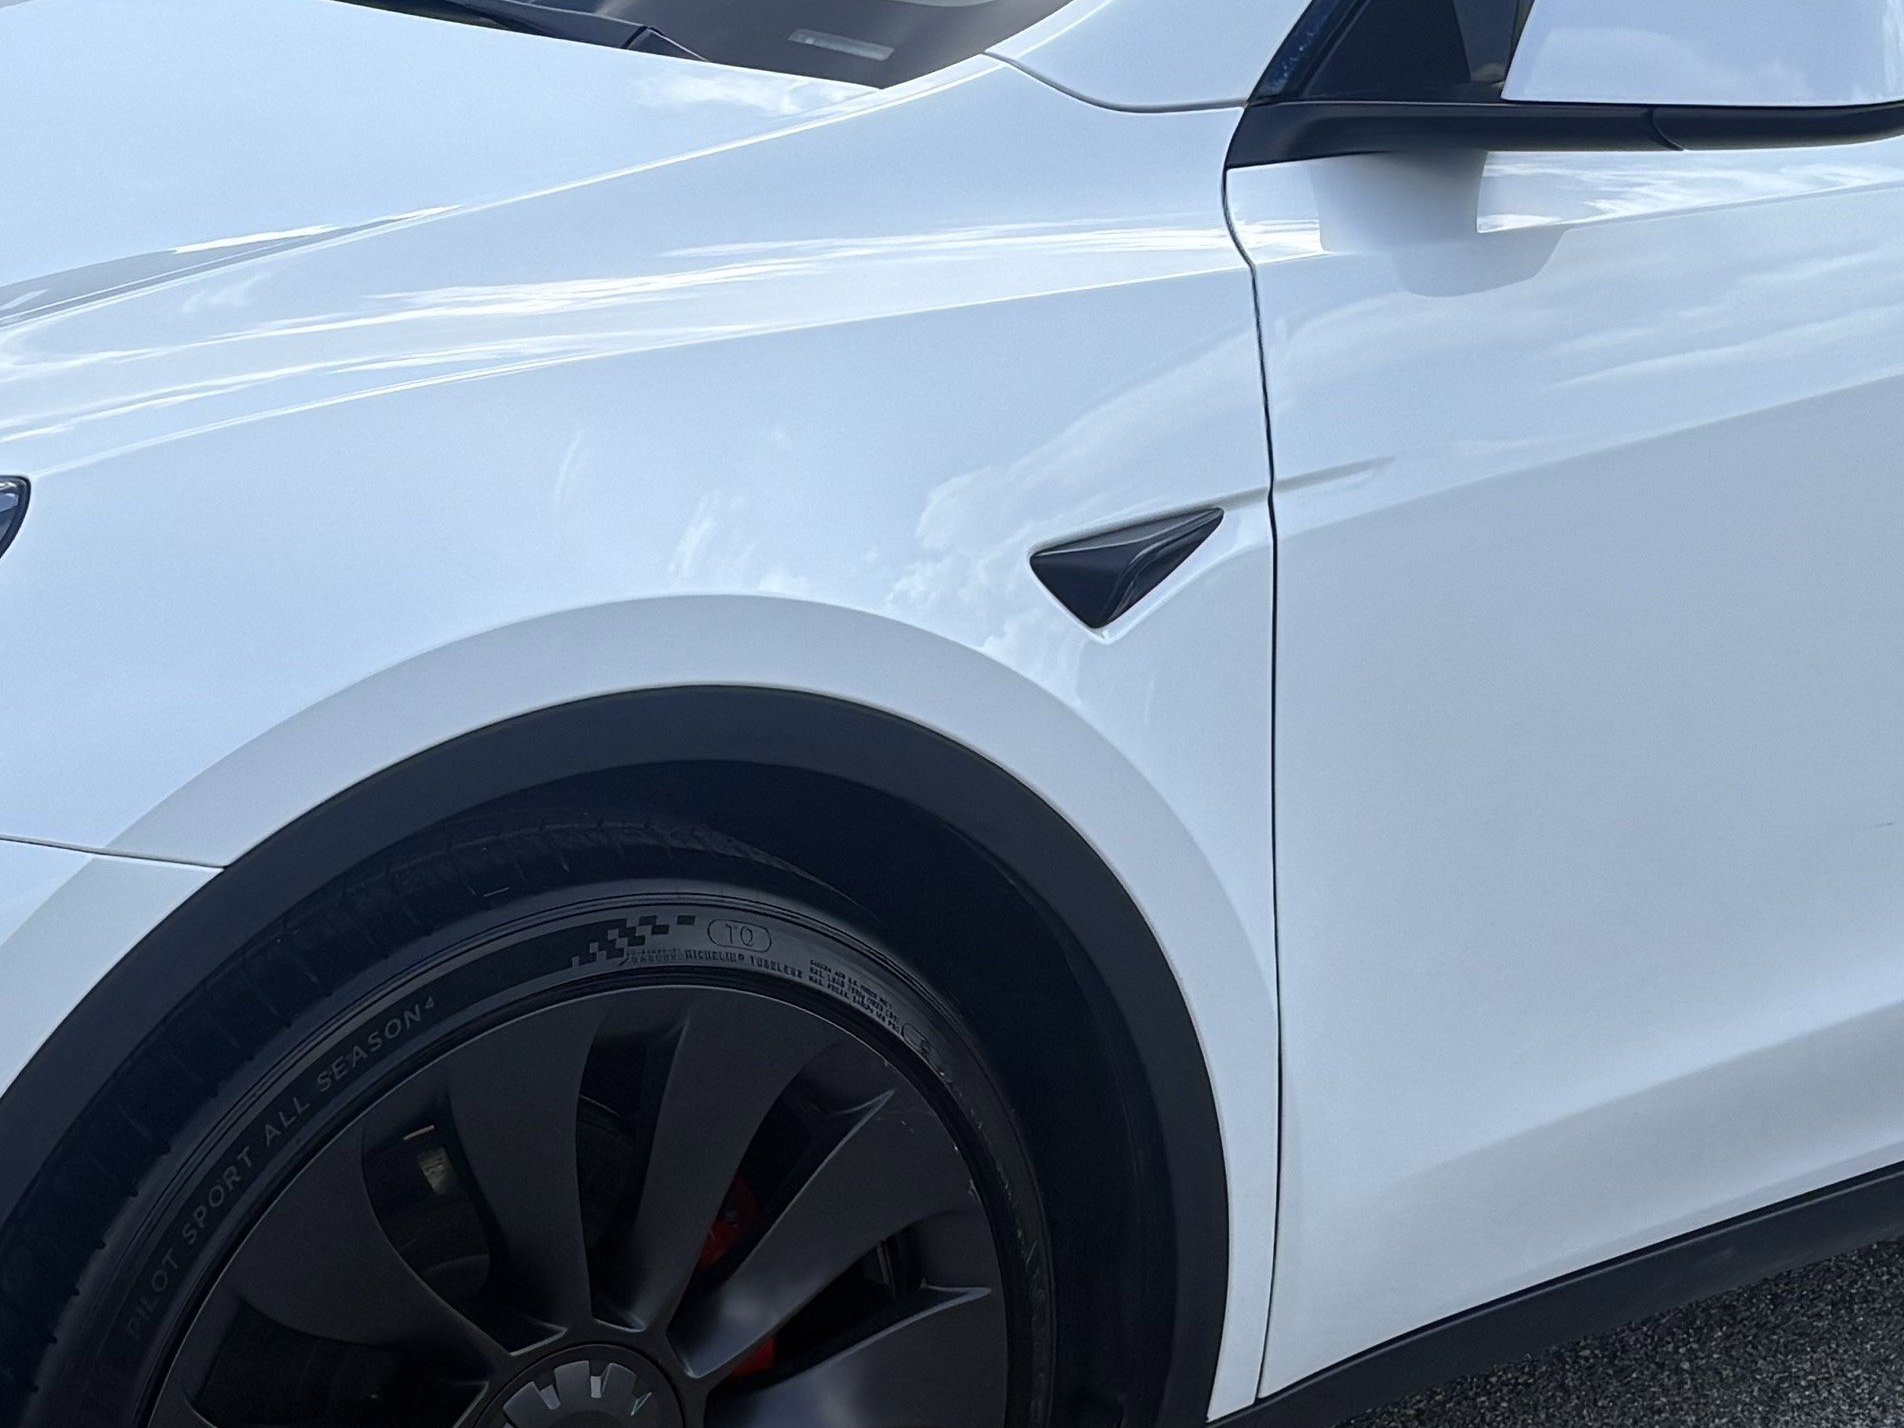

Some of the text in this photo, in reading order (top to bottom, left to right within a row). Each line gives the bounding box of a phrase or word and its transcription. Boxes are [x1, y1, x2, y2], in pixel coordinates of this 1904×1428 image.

[126, 1245, 179, 1340] PILOT
[181, 1146, 256, 1245] SPORT
[262, 1096, 311, 1147] ALL
